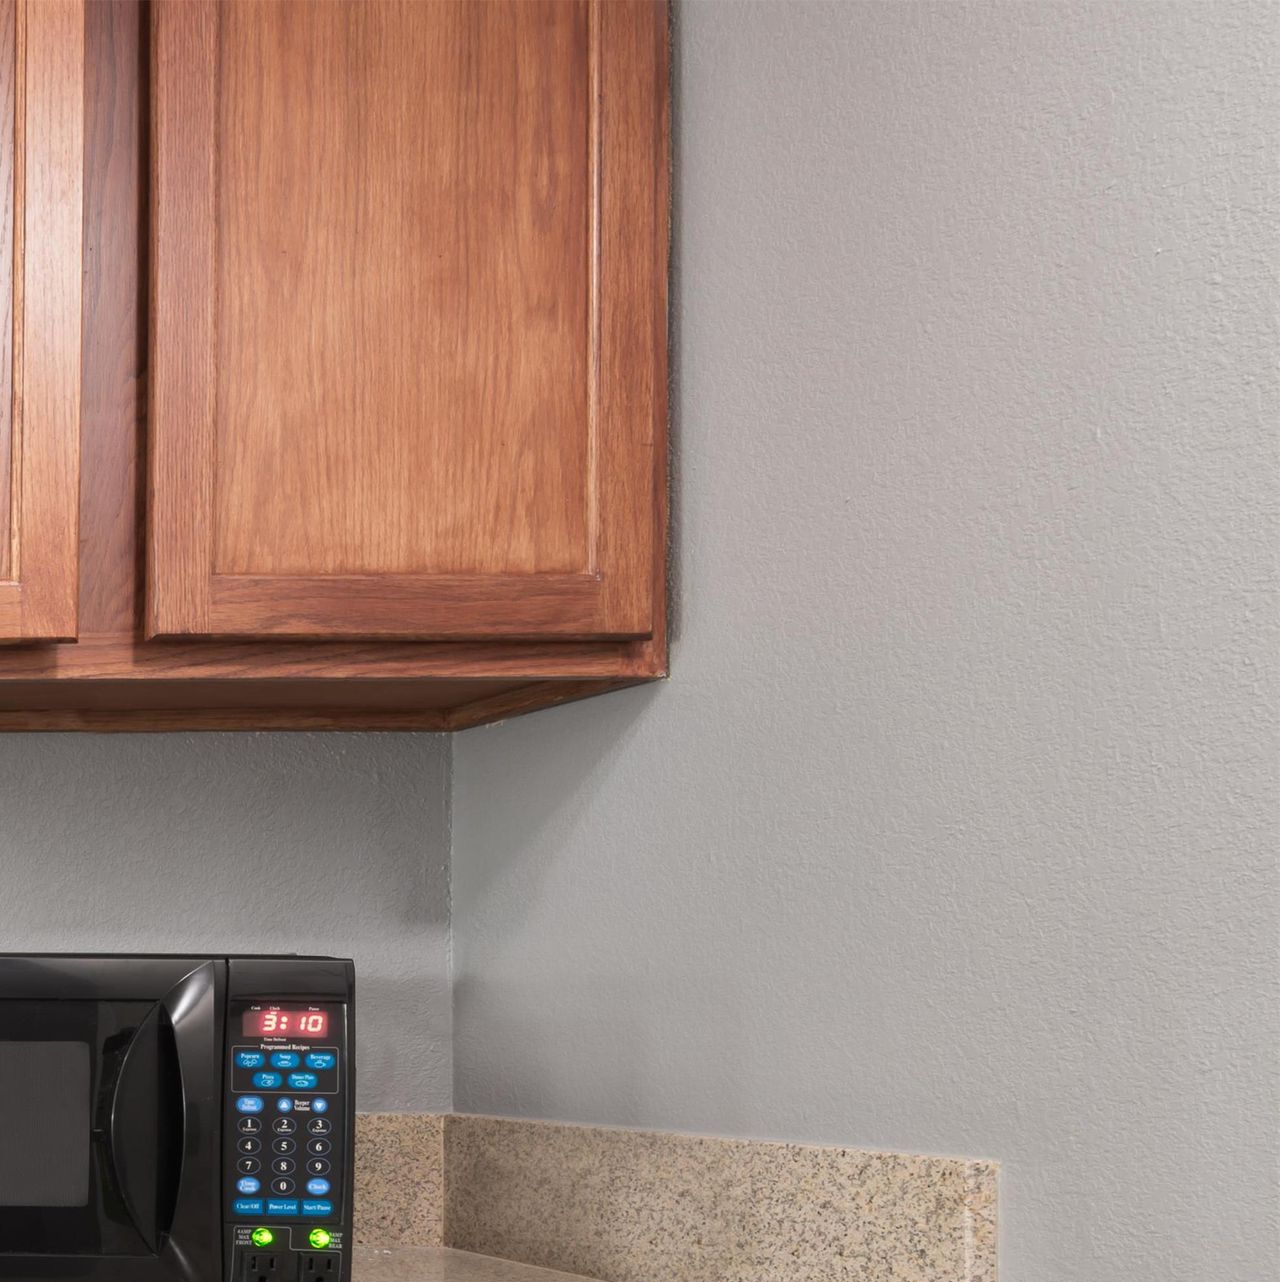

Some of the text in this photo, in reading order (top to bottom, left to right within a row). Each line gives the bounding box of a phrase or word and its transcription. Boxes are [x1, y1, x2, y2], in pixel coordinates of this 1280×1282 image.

[262, 1014, 324, 1032] 3:10
[247, 1119, 252, 1128] 1
[281, 1119, 288, 1128] 2
[315, 1120, 323, 1129] 3
[245, 1141, 252, 1150] 4
[280, 1142, 288, 1150] 5
[315, 1143, 322, 1151] 6
[245, 1161, 252, 1170] 7
[280, 1162, 287, 1170] 8
[315, 1162, 322, 1171] 9
[280, 1182, 287, 1191] 0
